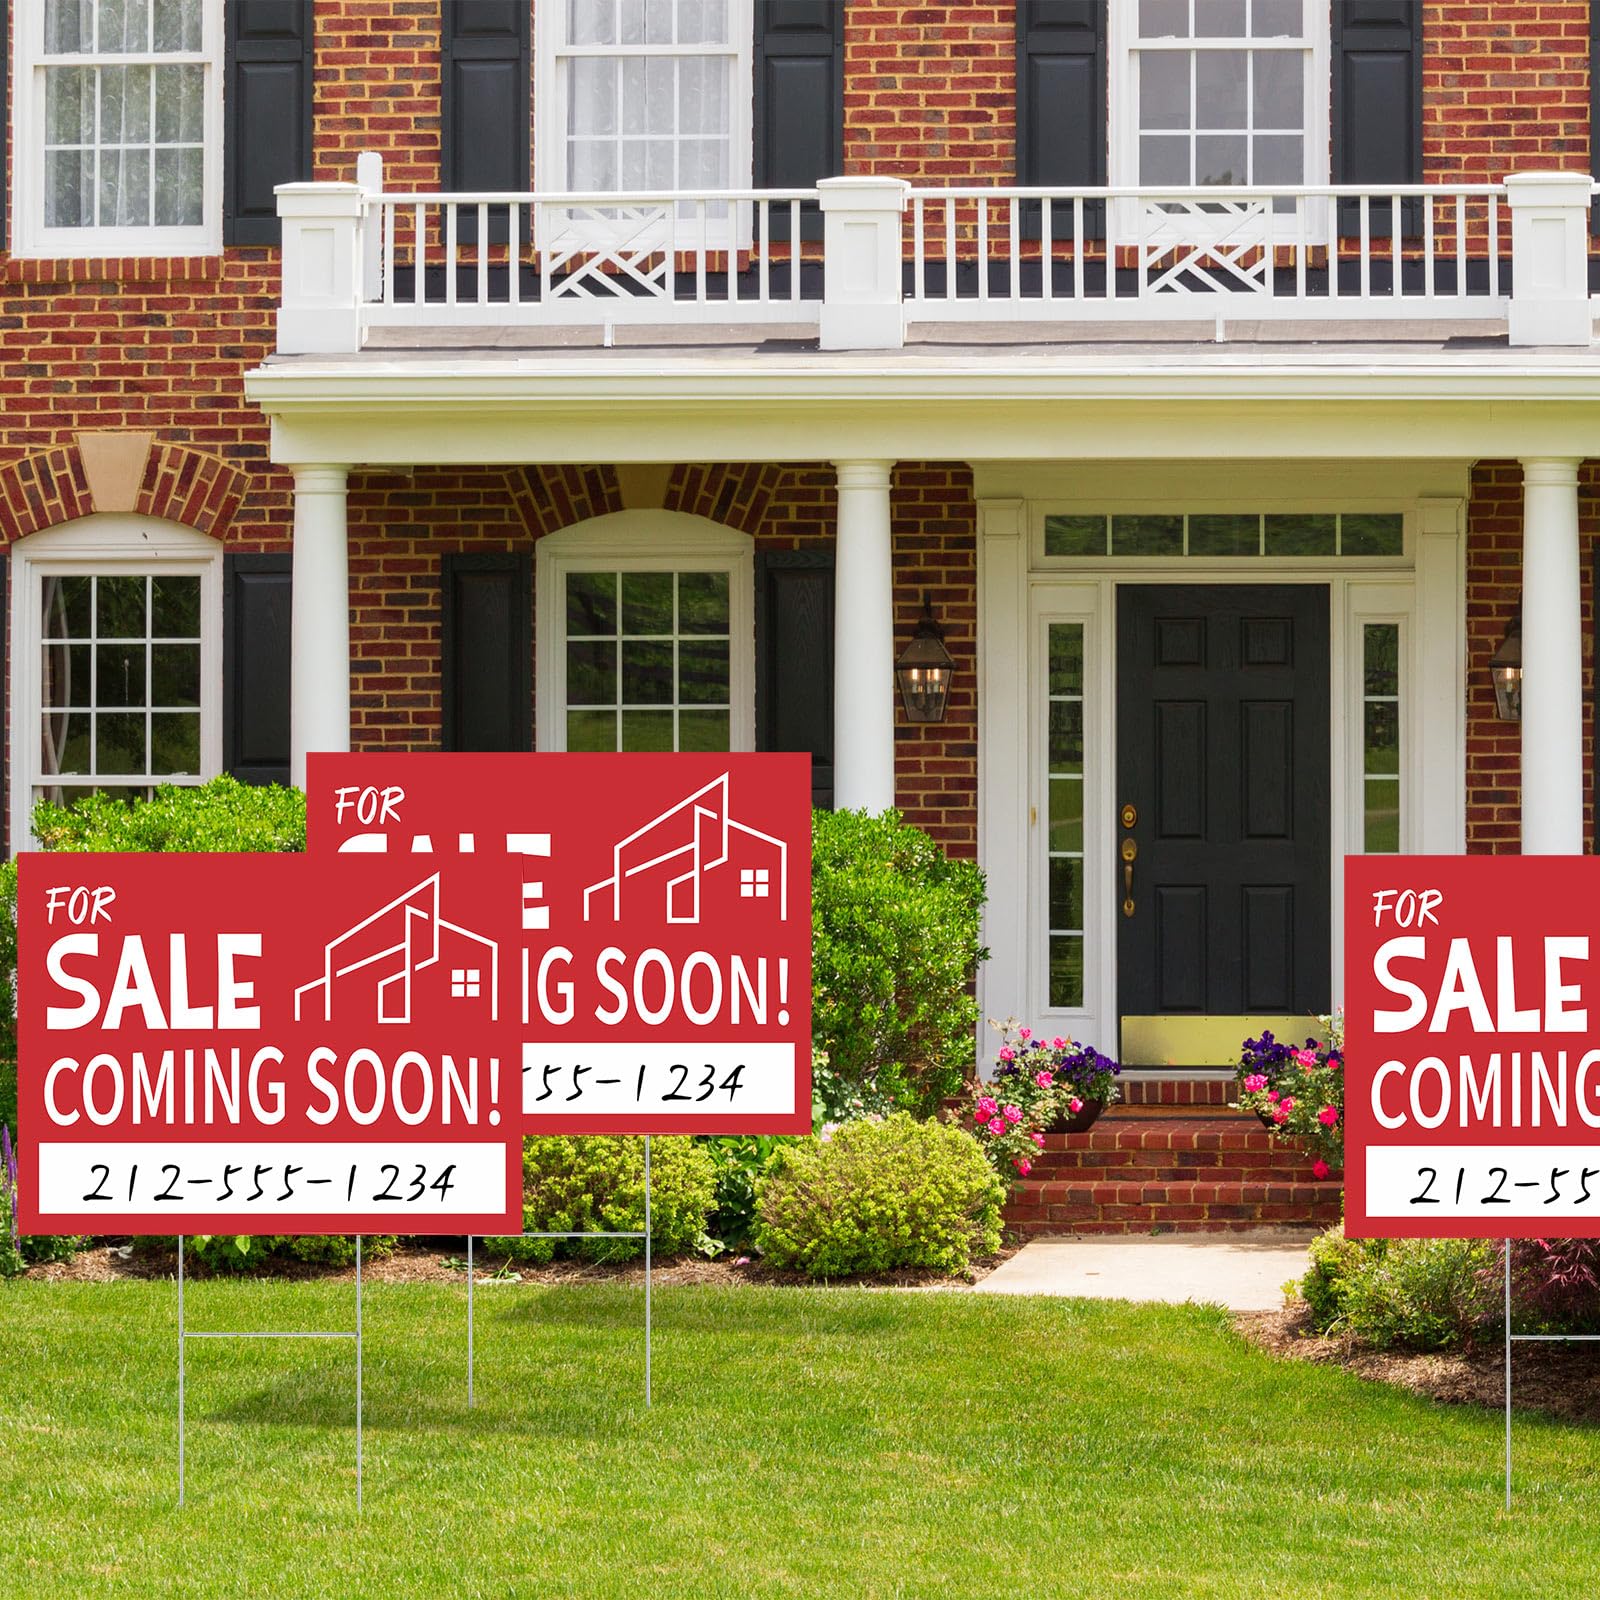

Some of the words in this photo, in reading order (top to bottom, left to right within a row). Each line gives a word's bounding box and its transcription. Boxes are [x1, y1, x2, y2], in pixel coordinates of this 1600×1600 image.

[335, 786, 404, 825] FOR
[46, 886, 116, 925] FOR
[1373, 889, 1442, 928] FOR
[47, 934, 261, 1029] SALE
[595, 947, 789, 1026] SOON!
[1374, 937, 1588, 1032] SALE
[44, 1047, 285, 1127] COMING
[306, 1047, 500, 1126] SOON!
[1371, 1050, 1600, 1129] COMING
[83, 1164, 456, 1202] 212-555-1234
